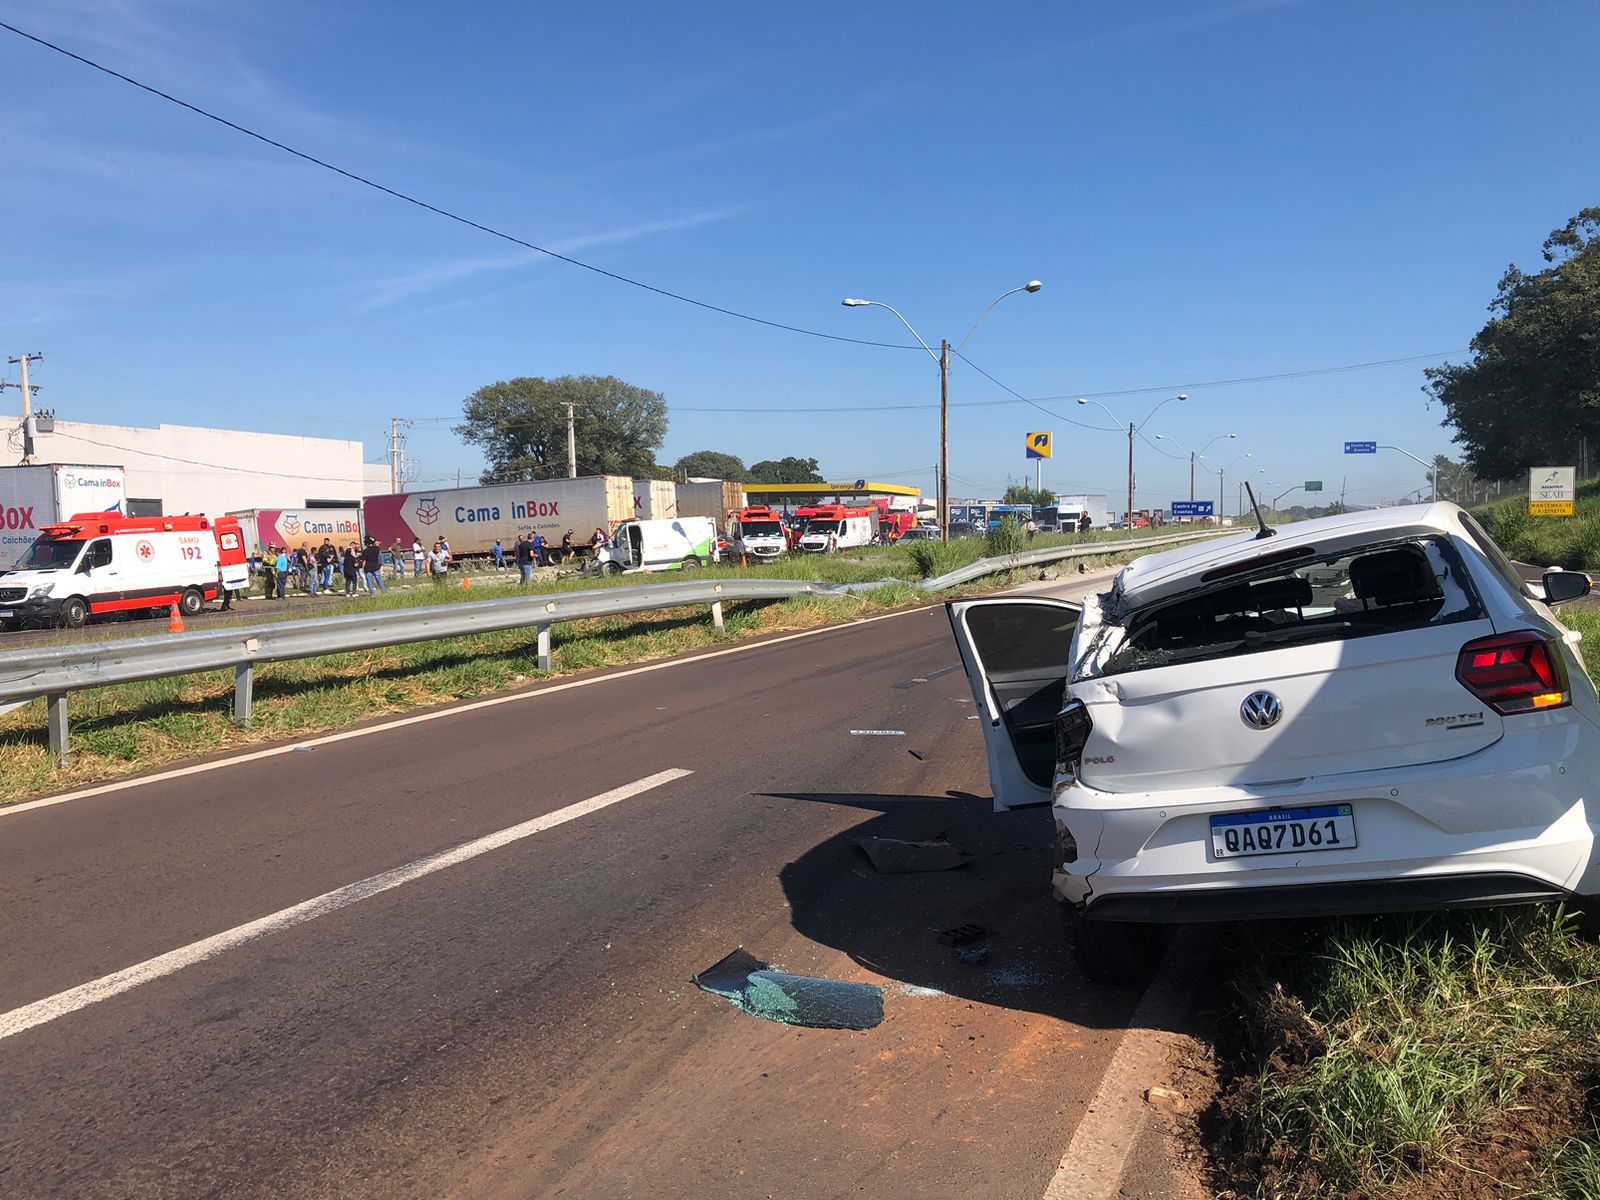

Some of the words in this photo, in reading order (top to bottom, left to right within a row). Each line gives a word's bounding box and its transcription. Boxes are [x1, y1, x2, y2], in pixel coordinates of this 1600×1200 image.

[77, 478, 99, 487] Cama
[100, 478, 121, 488] inBox
[1541, 491, 1564, 499] SEAB
[455, 506, 500, 523] Cama
[511, 500, 560, 519] inBox
[304, 520, 333, 534] Cama
[178, 536, 199, 544] SAMU
[180, 546, 202, 560] 192
[1084, 756, 1115, 765] POLO
[1224, 820, 1340, 852] QAQ7D61
[1216, 849, 1224, 857] BR
